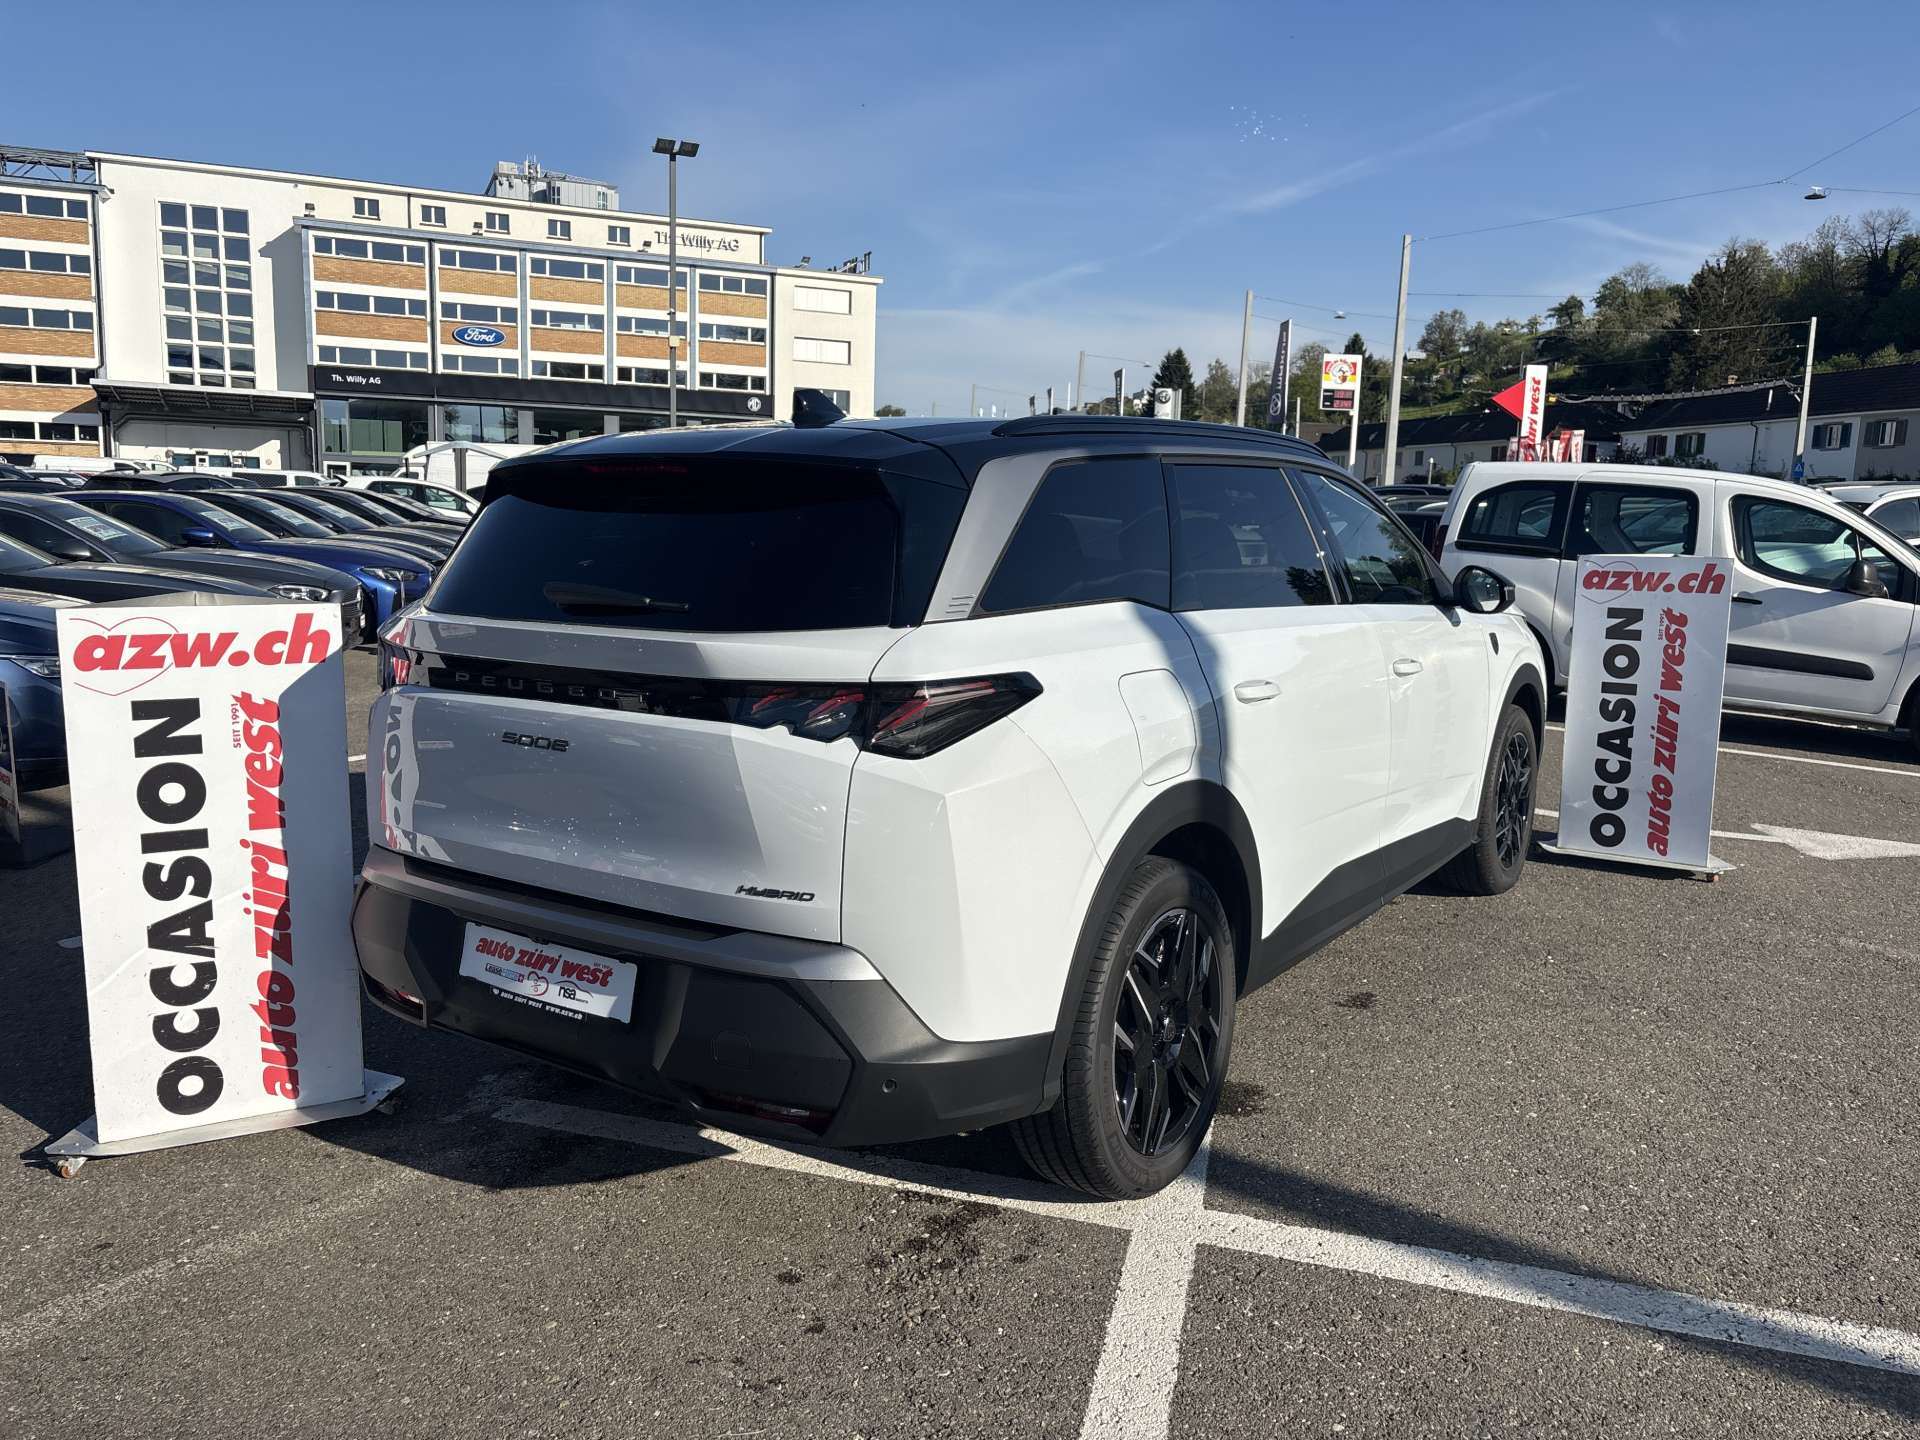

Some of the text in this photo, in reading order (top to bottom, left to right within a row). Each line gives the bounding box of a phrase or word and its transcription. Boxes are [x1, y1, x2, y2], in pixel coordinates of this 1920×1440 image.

[680, 233, 714, 252] Willy
[717, 237, 740, 252] AG
[464, 327, 496, 342] Ford
[346, 375, 367, 385] Willy
[1529, 376, 1541, 415] west
[1582, 563, 1726, 594] azw.ch
[73, 613, 331, 672] azw.ch
[231, 703, 241, 749] SEIT 1991
[1590, 606, 1644, 848] OCCASION
[1647, 607, 1690, 857] auto züri west
[130, 697, 225, 1116] OCCASION
[230, 691, 301, 1101] auto züri west
[735, 885, 816, 902] HYBRID
[475, 937, 614, 987] auto züri west
[558, 986, 576, 1001] nsa
